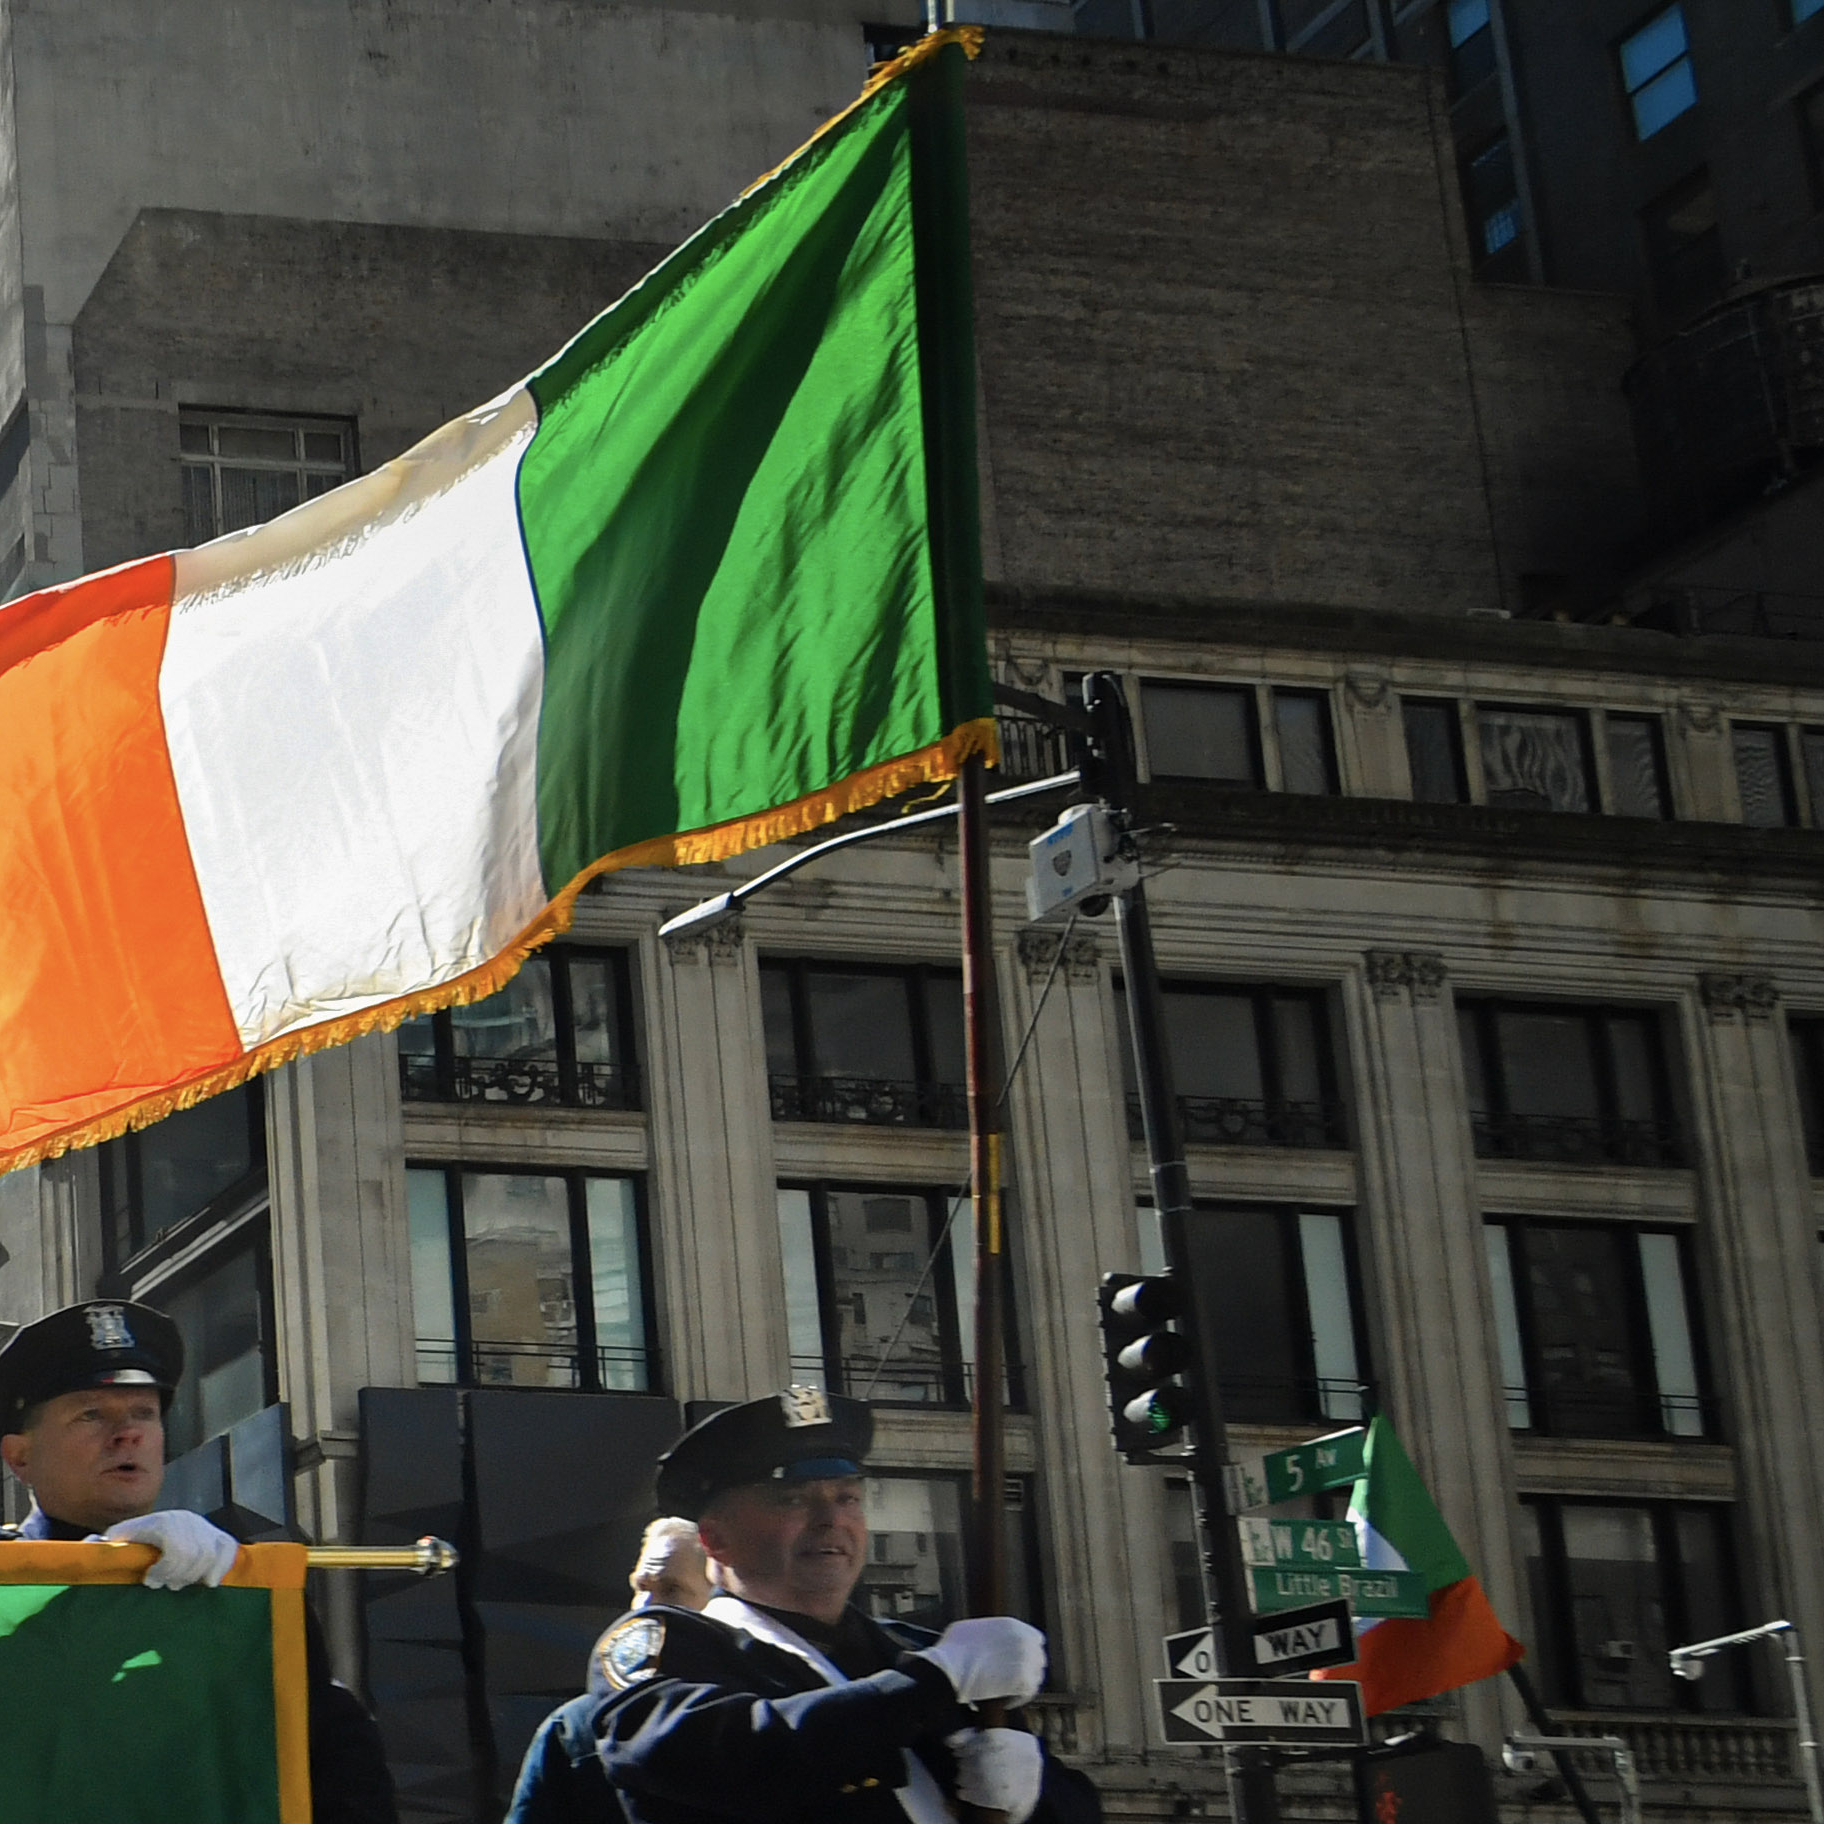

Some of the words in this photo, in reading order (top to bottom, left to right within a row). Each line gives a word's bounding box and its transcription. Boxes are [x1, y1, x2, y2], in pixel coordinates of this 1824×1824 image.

[1285, 1454, 1304, 1492] 5
[1270, 1525, 1293, 1559] W
[1302, 1527, 1333, 1561] 46
[1276, 1573, 1331, 1597] Little
[1339, 1573, 1399, 1598] Brazil
[1267, 1623, 1326, 1657] WAY
[1193, 1700, 1255, 1723] ONE
[1279, 1701, 1337, 1725] WAY
